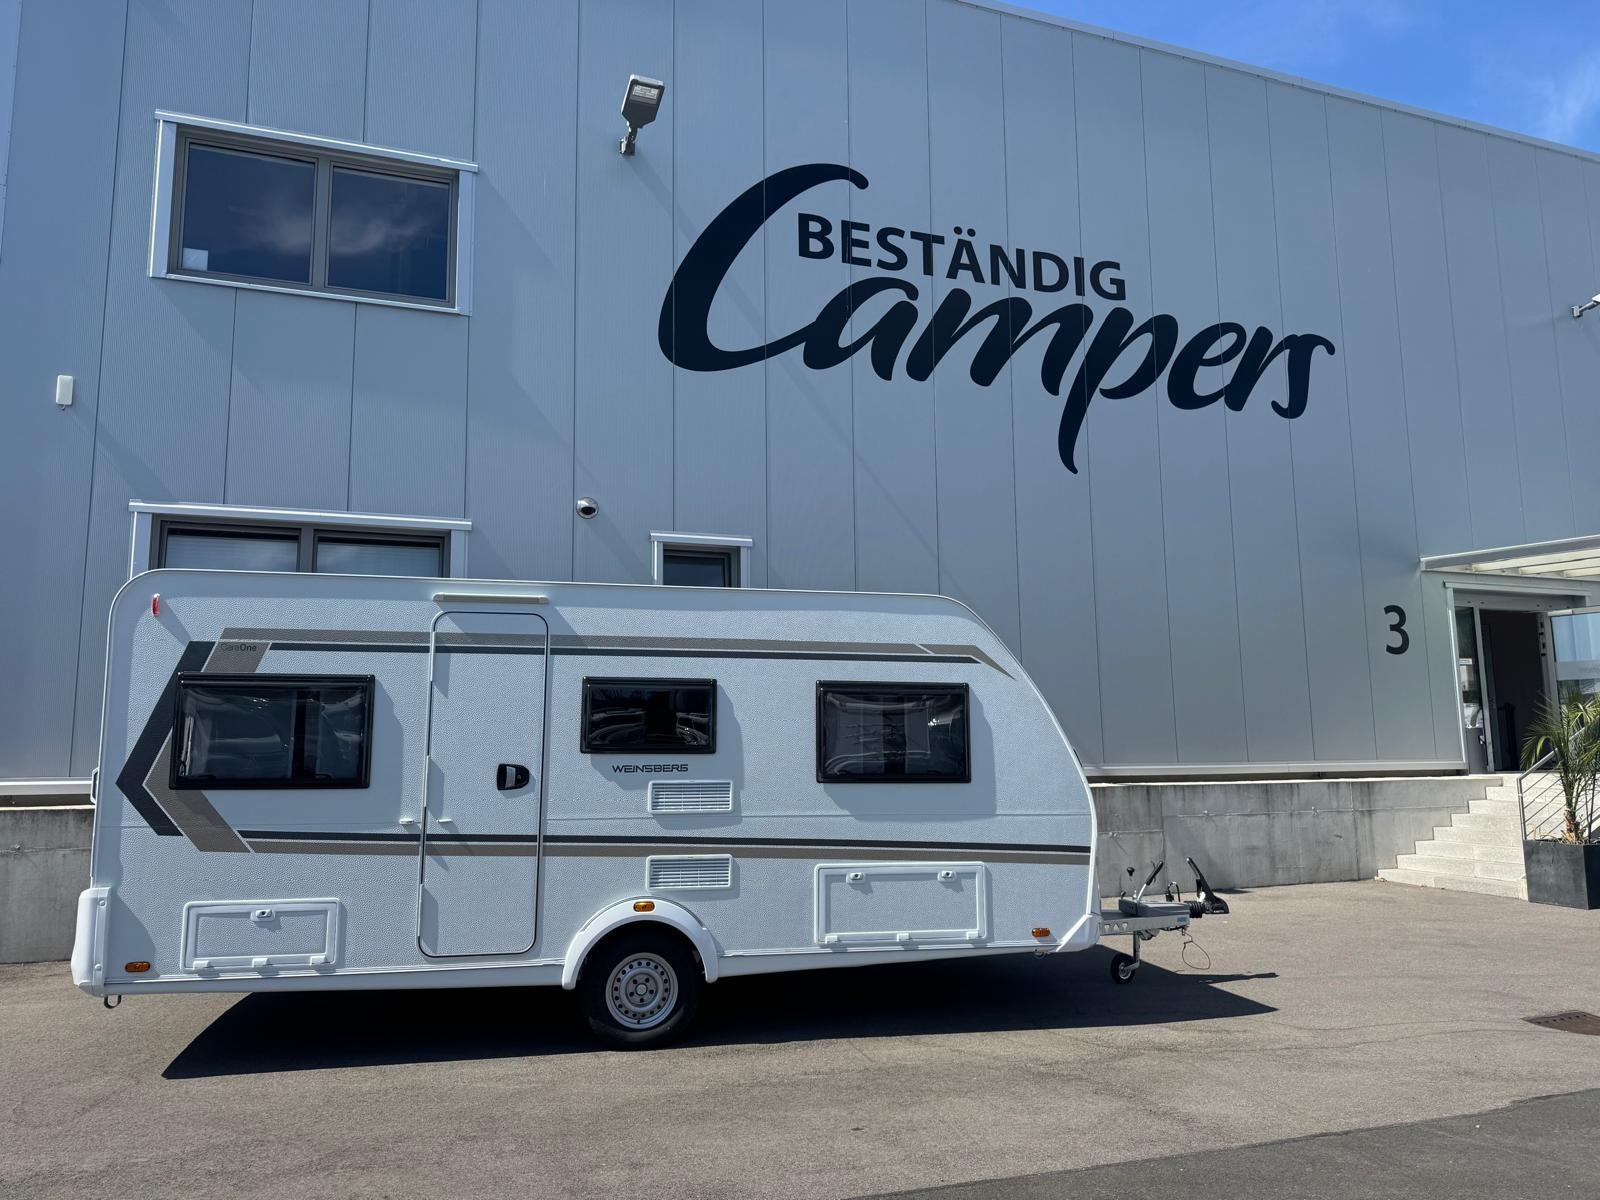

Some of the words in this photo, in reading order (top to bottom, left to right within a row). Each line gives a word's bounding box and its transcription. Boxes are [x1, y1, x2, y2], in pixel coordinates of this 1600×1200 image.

[797, 212, 1127, 302] BESTÄNDIG
[657, 162, 1336, 475] Campers
[220, 643, 257, 652] CaraOne
[1383, 604, 1410, 656] 3
[611, 763, 689, 774] WEINSBERG
